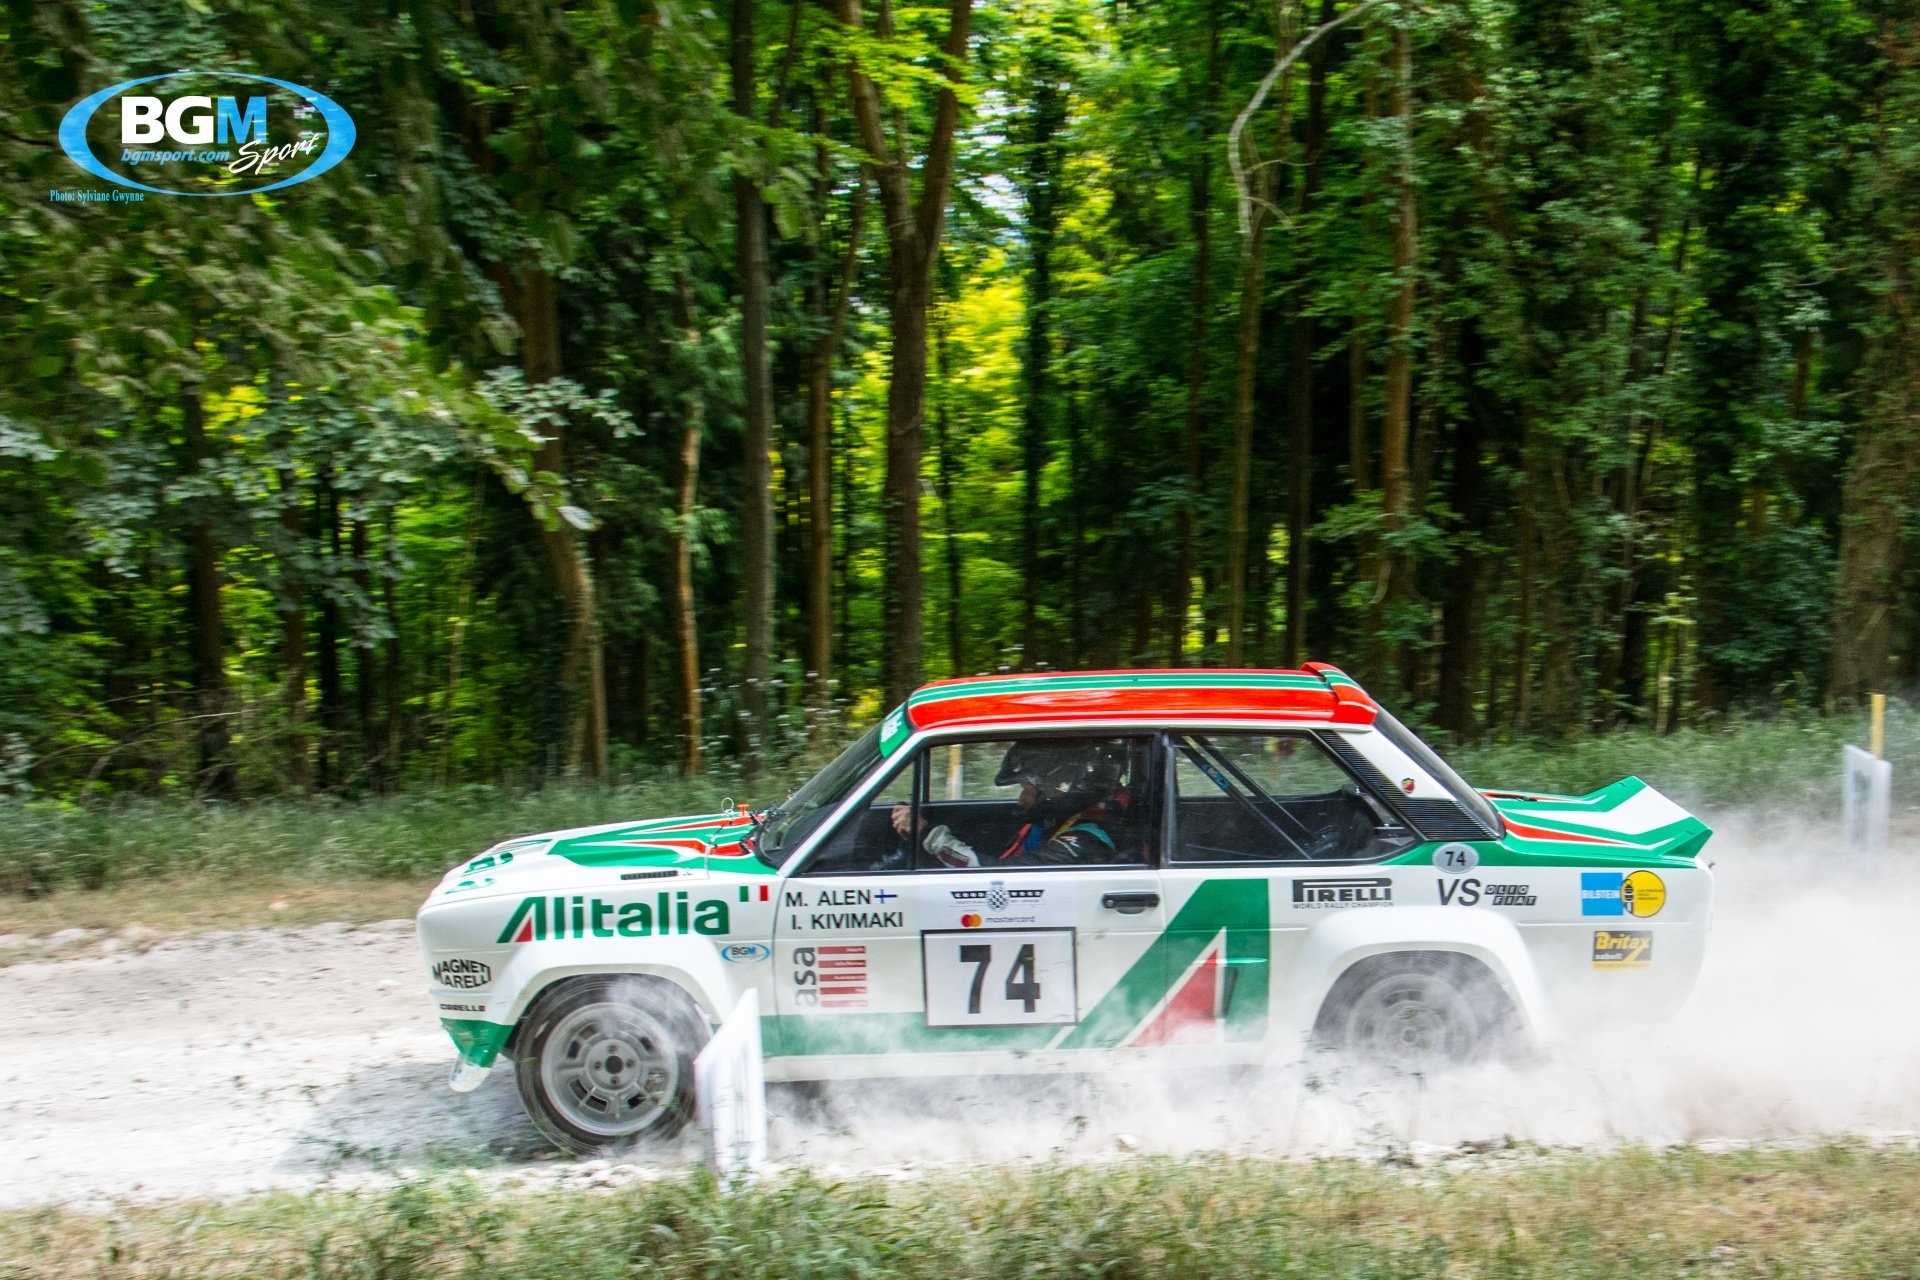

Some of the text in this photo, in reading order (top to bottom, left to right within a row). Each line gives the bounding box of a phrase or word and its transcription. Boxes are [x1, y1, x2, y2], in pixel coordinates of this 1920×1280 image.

[1445, 851, 1466, 866] 74
[785, 889, 871, 907] M. ALEN
[1292, 878, 1392, 902] PIRELLI
[1437, 878, 1481, 906] VS
[1493, 896, 1537, 906] FIAT
[497, 891, 730, 943] Alitalia
[811, 912, 903, 929] KIVIMAKI
[1595, 931, 1651, 954] Britax
[959, 943, 1041, 1014] 74
